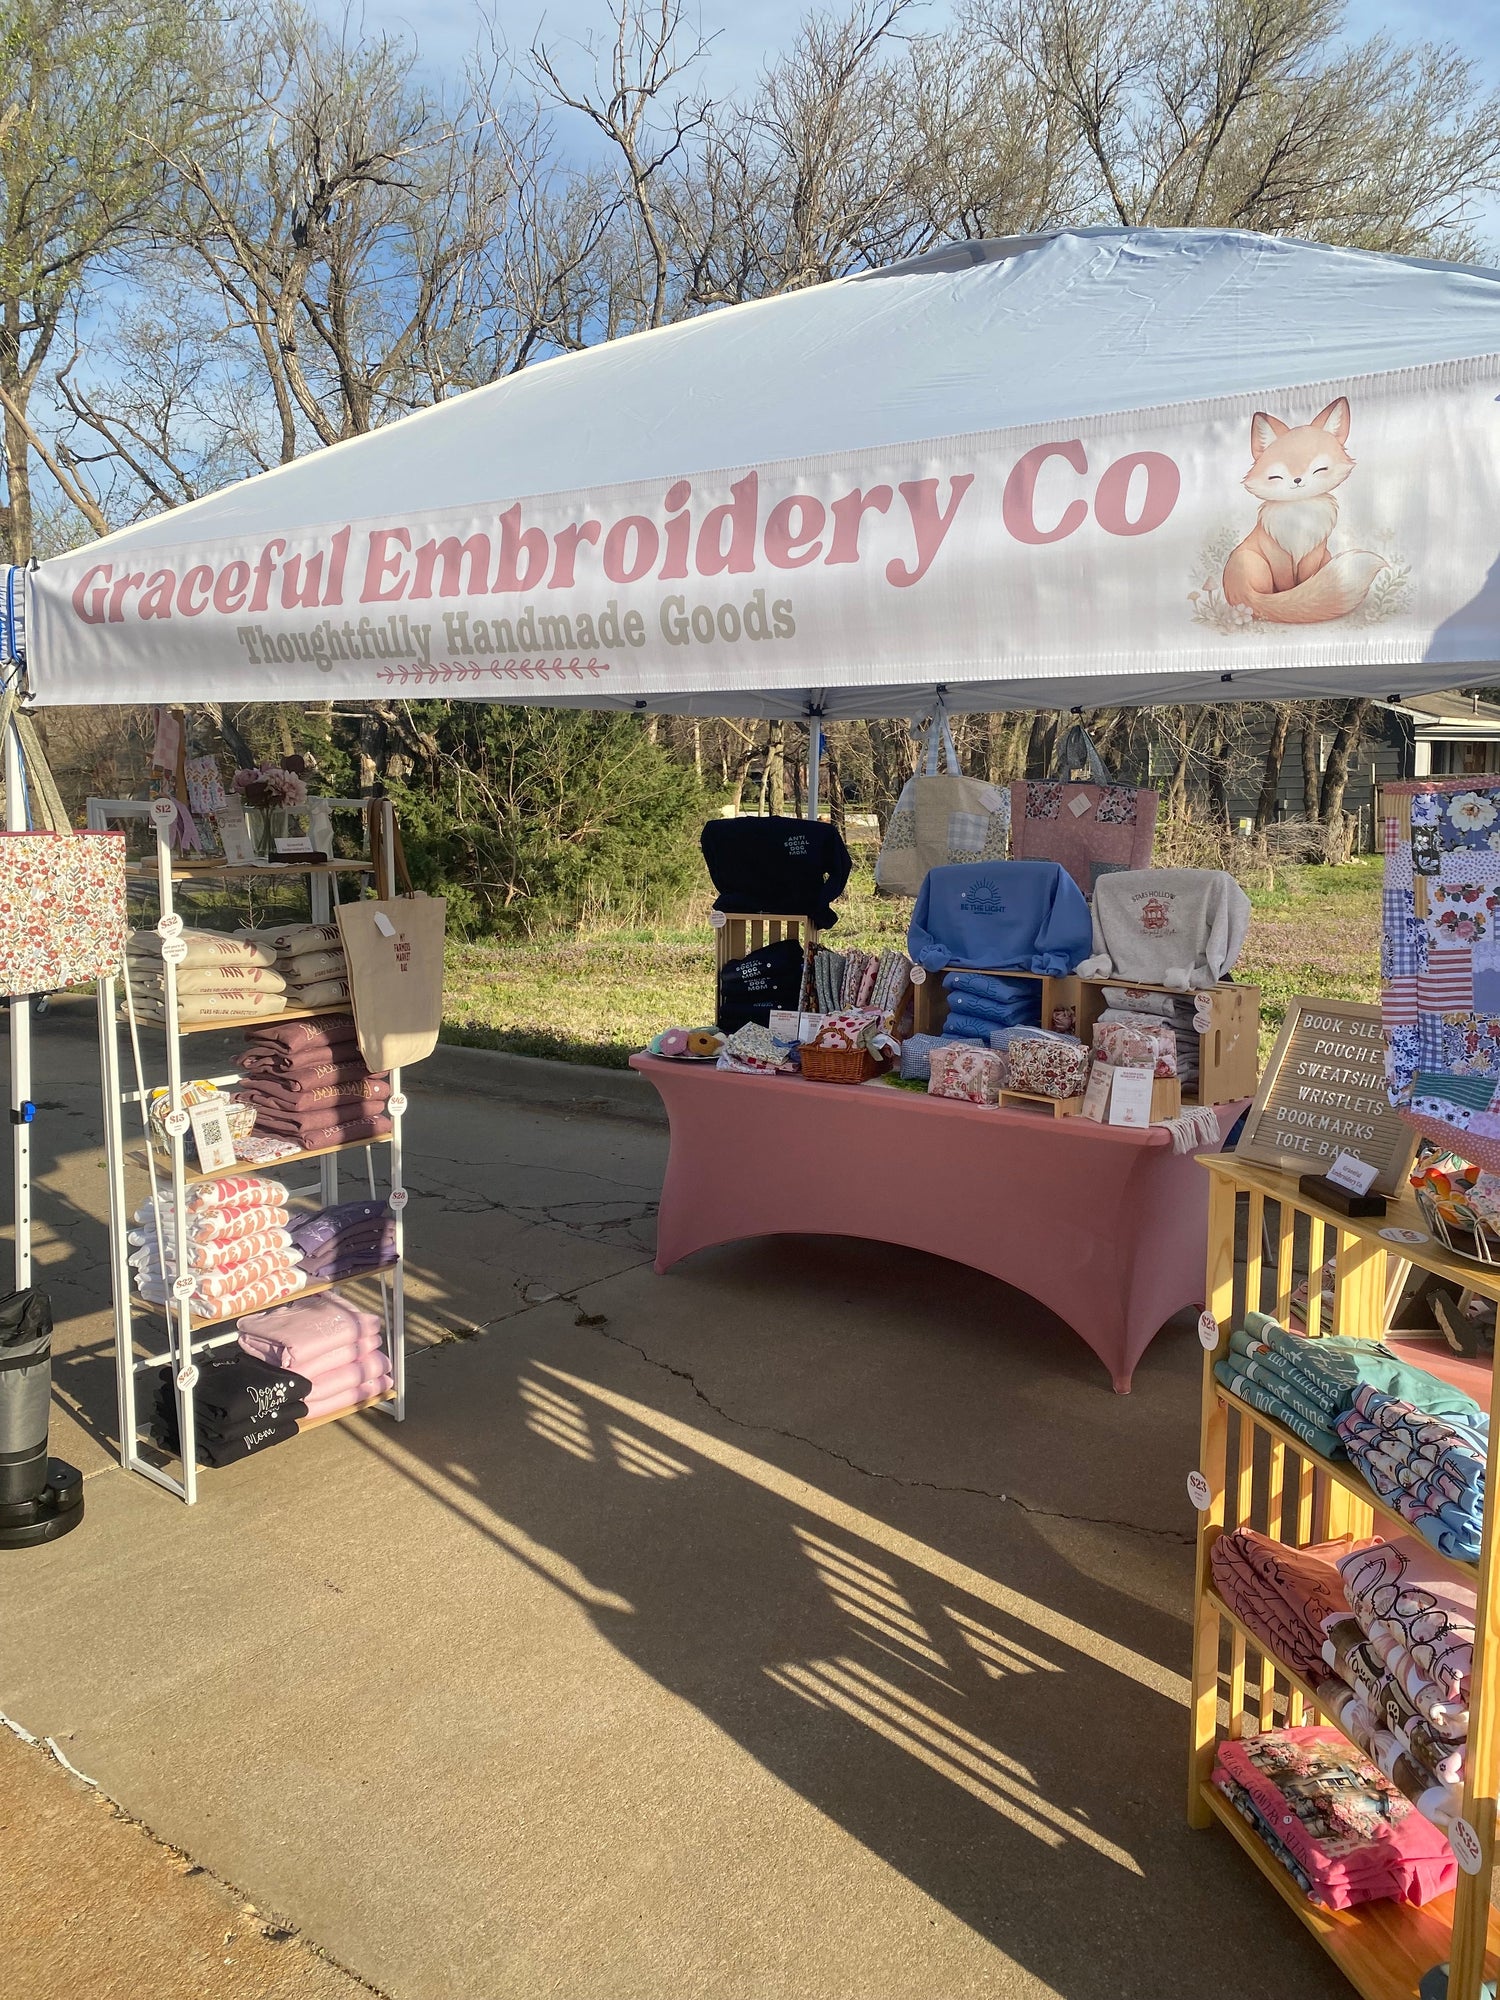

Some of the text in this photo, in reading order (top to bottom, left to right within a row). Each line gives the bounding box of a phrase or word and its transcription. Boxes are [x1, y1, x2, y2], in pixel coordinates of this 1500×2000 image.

[72, 438, 1181, 626] Graceful Embroidery Co
[238, 588, 796, 673] Thoughtfully Handmade Goods
[155, 804, 171, 813] $12
[1132, 891, 1176, 902] STARS HOLLOW
[985, 905, 1006, 913] LIGHT
[742, 966, 758, 975] DOG
[1303, 1015, 1344, 1033] BOOK
[1314, 1040, 1385, 1064] POUCHE
[1297, 1062, 1387, 1091] SWEATSHIR
[1298, 1086, 1385, 1116] WRISTLETS
[1276, 1106, 1375, 1140] BOOKMARKS
[1275, 1131, 1313, 1153] TOTE
[1200, 1314, 1216, 1333] $23
[246, 1385, 277, 1404] Dog
[1303, 1367, 1339, 1399] mine
[257, 1395, 288, 1413] Mom
[1293, 1399, 1325, 1428] mine
[243, 1427, 276, 1450] Mom
[1280, 1408, 1315, 1446] mine
[1190, 1475, 1207, 1493] $23
[1455, 1821, 1479, 1859] $32
